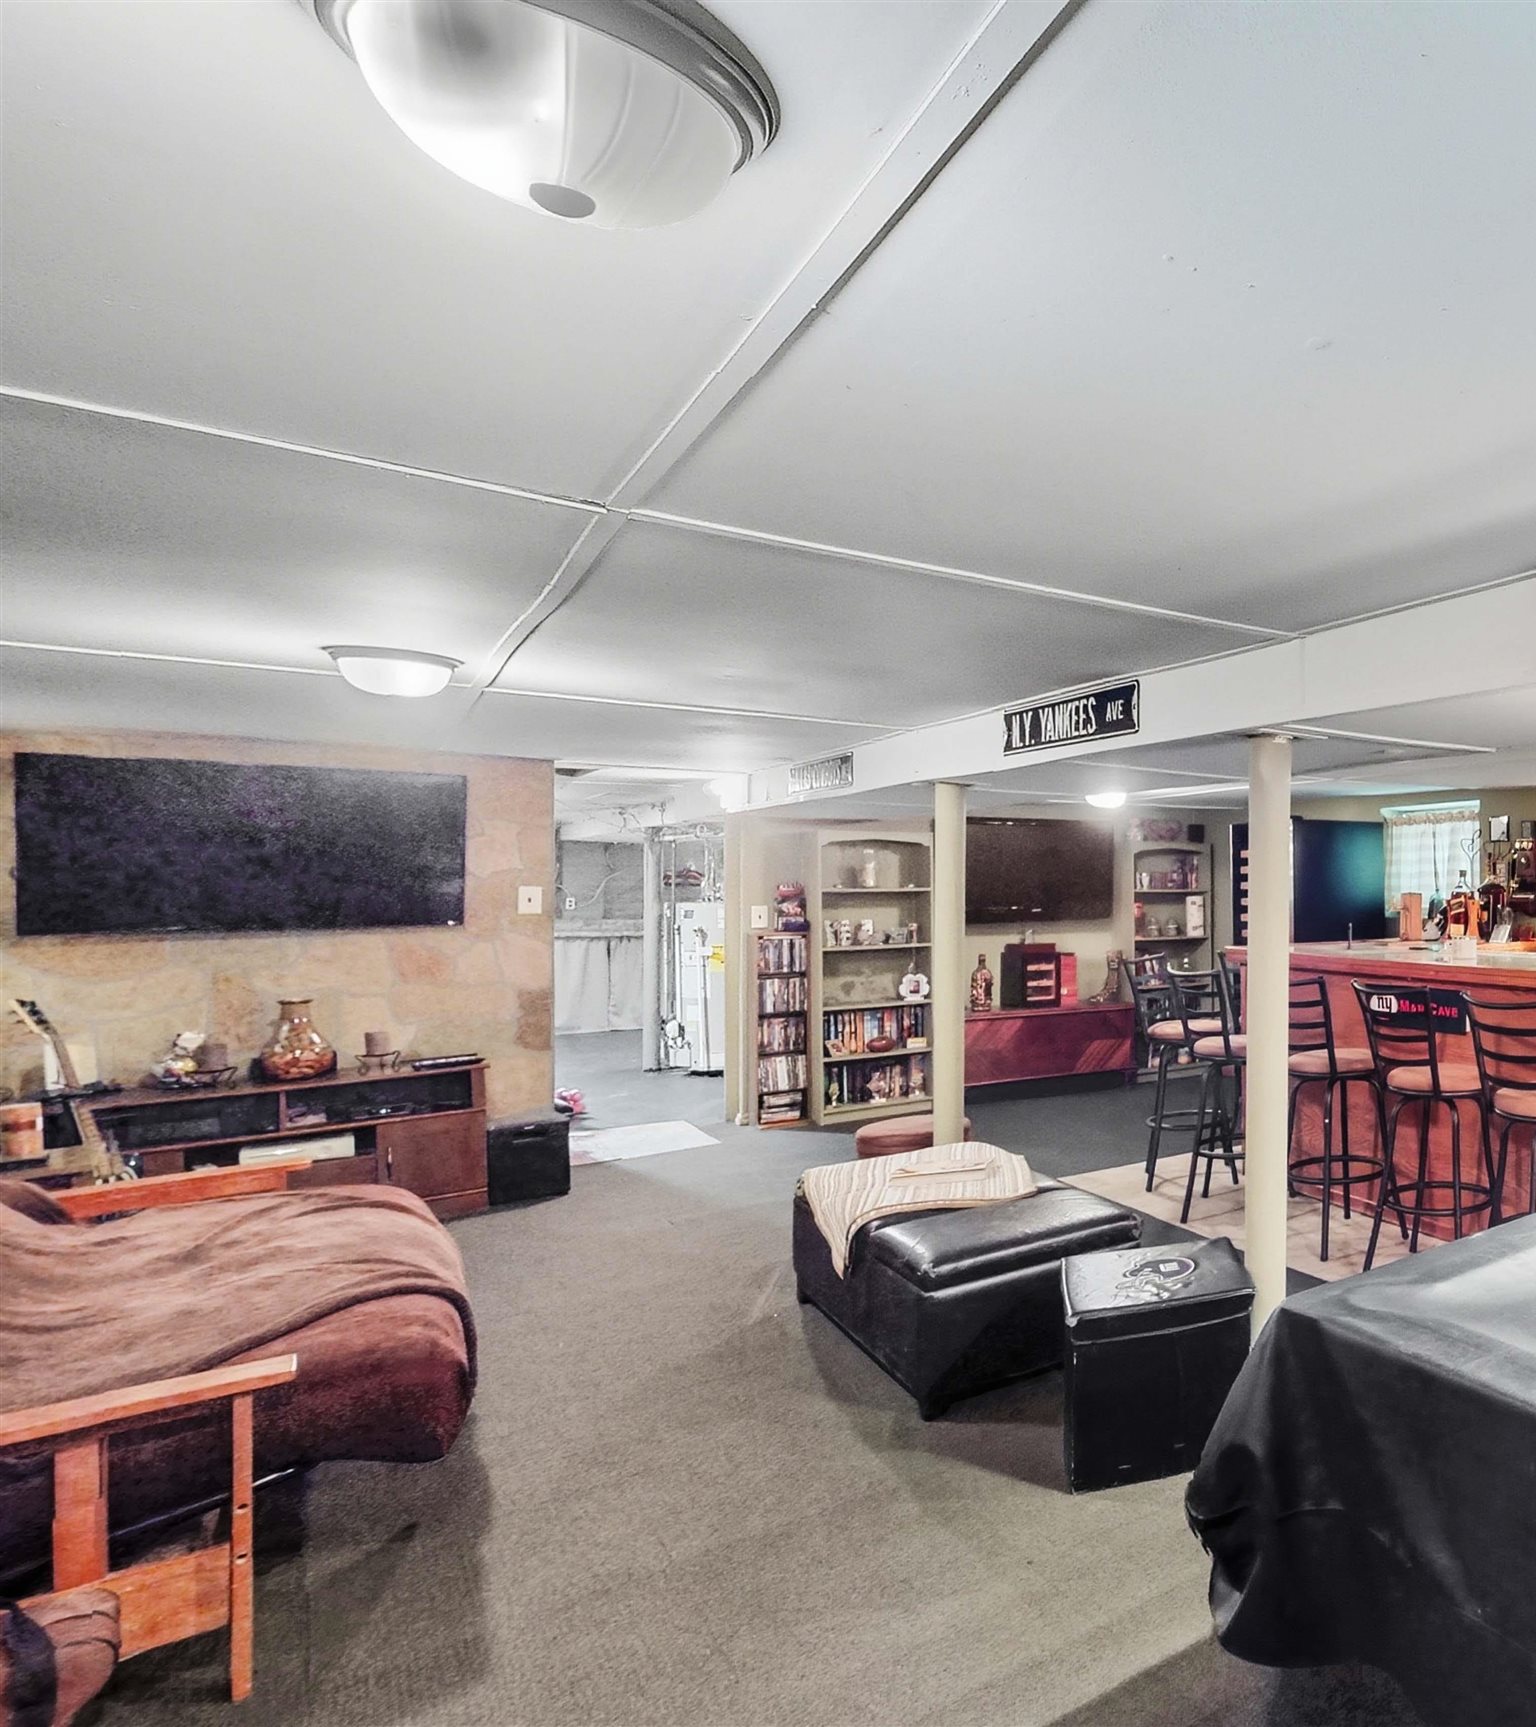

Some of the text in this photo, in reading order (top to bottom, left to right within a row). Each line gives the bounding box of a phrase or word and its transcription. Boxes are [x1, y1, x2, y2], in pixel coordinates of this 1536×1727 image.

[1011, 696, 1124, 749] N.Y. YANKEES AVE
